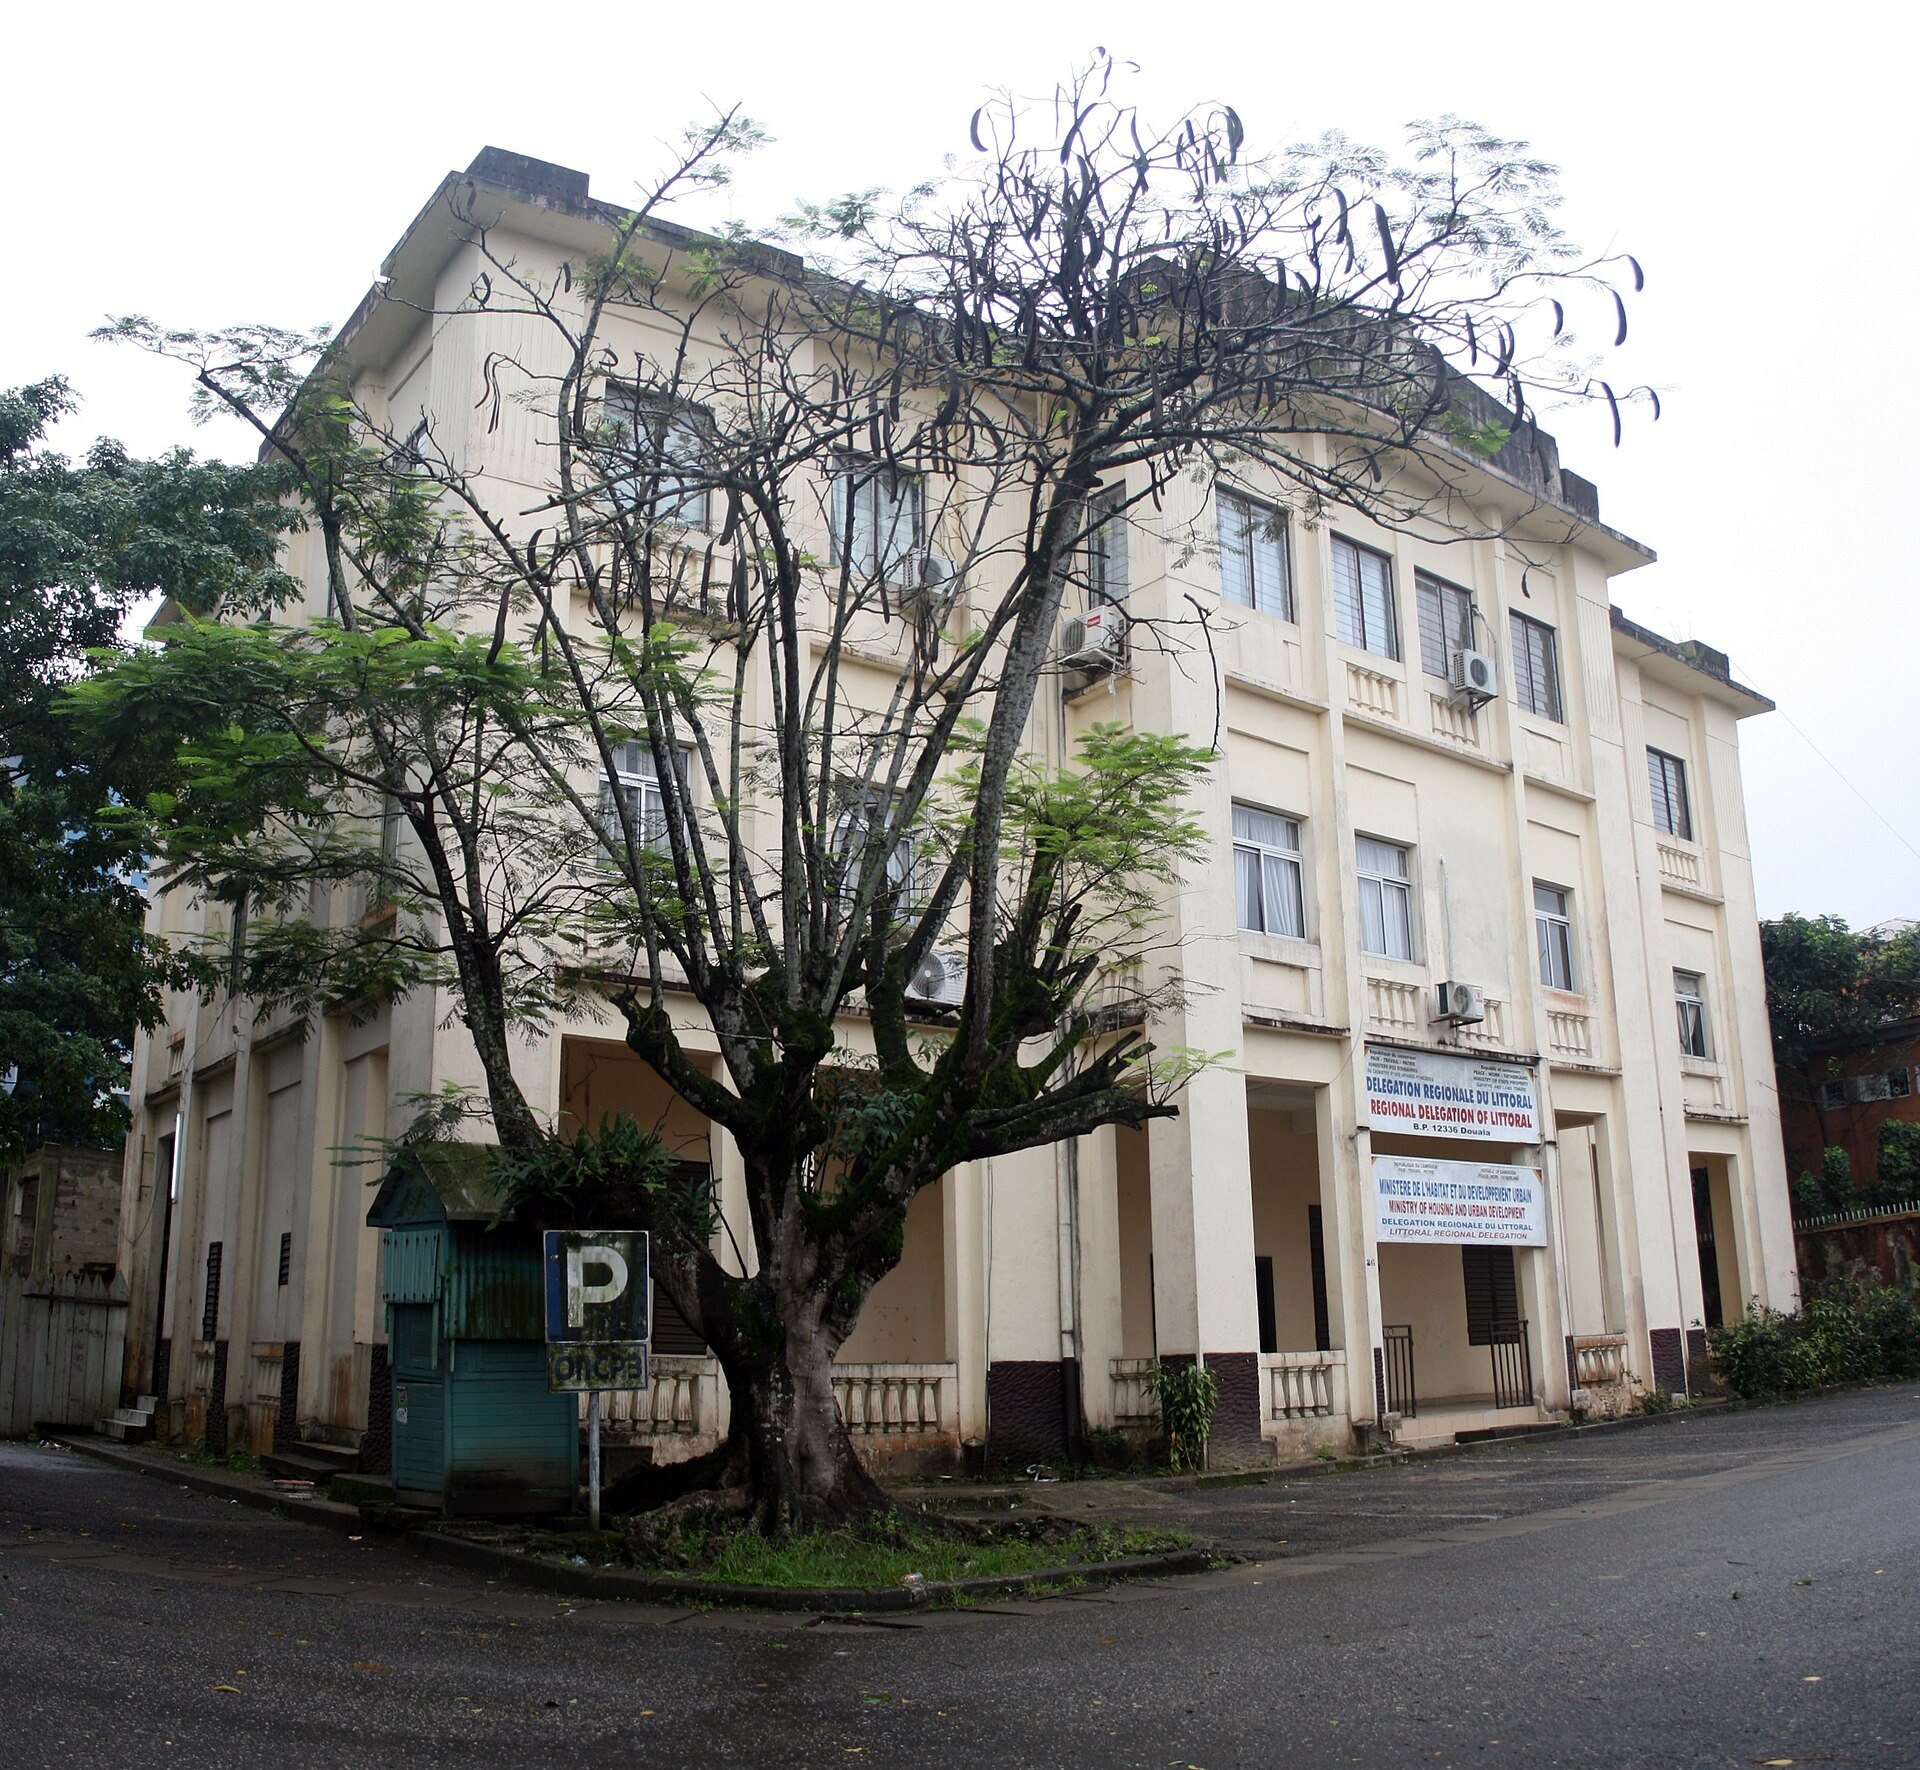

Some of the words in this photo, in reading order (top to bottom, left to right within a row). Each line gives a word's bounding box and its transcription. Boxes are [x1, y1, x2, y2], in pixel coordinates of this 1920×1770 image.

[1366, 1076, 1420, 1097] DELEGATION
[1424, 1084, 1474, 1103] REGIONALE
[1477, 1090, 1488, 1105] DU
[1492, 1092, 1532, 1109] LITTORAL
[1371, 1099, 1416, 1118] REGIONAL
[1418, 1104, 1474, 1123] DELEGATION
[1477, 1110, 1488, 1124] OF
[1491, 1112, 1532, 1128] LITTORAL
[1432, 1124, 1458, 1133] 12336
[1461, 1127, 1490, 1136] Douala
[1379, 1179, 1411, 1196] MINISTERE
[1413, 1181, 1420, 1196] DE
[1422, 1181, 1448, 1199] L'HABITAT
[1450, 1184, 1457, 1199] ET
[1459, 1184, 1466, 1199] DU
[1467, 1185, 1511, 1202] DEVELOPPEMENT
[1513, 1188, 1532, 1203] URBAIN
[1389, 1200, 1417, 1214] MINISTRY
[1420, 1202, 1427, 1214] OF
[1428, 1202, 1453, 1216] HOUSING
[1455, 1204, 1467, 1216] AND
[1468, 1204, 1488, 1217] URBAN
[1489, 1205, 1525, 1219] DEVELOPMENT
[1382, 1218, 1434, 1227] DELEGATION
[1437, 1221, 1483, 1229] REGIONALE
[1434, 1230, 1476, 1238] REGIONAL
[567, 1246, 628, 1328] P
